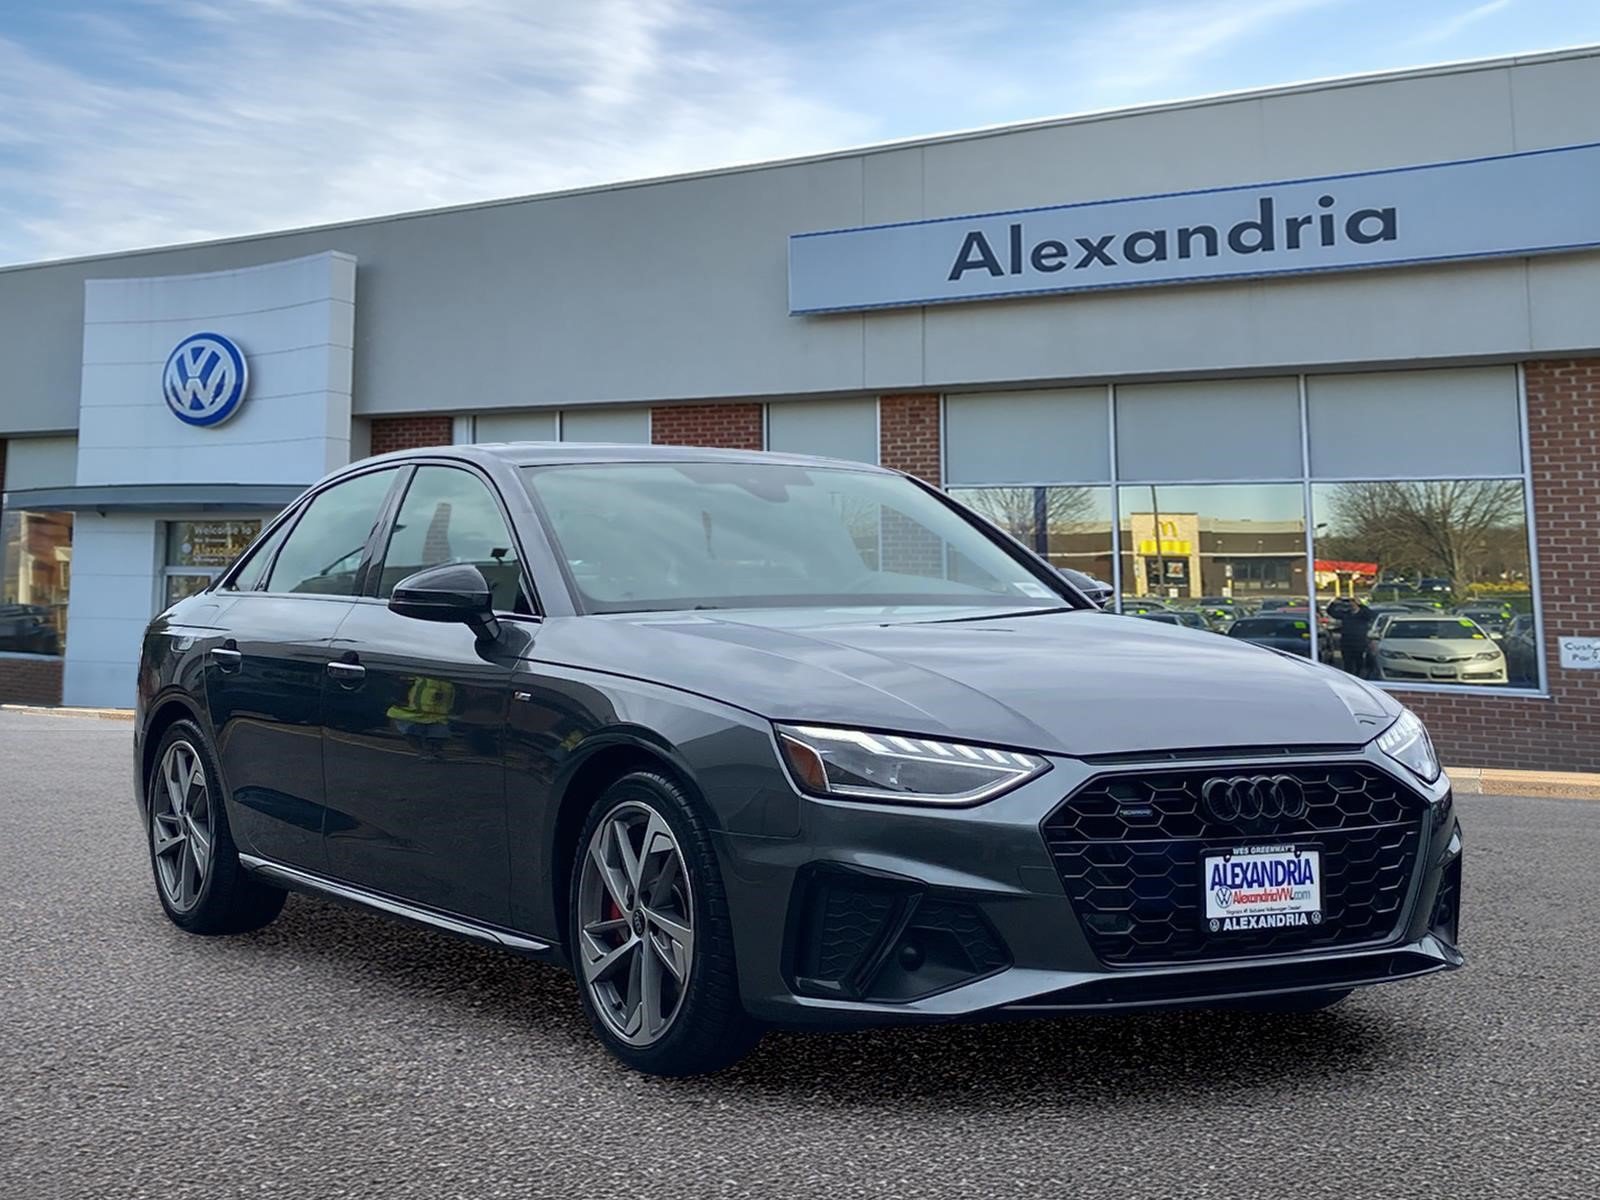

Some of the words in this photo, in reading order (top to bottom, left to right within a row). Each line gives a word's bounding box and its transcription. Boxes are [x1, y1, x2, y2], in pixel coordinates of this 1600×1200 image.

[948, 194, 1398, 281] Alexandria
[164, 336, 242, 424] VW
[1232, 846, 1249, 855] WES
[1210, 858, 1314, 891] ALEXANDRIA
[1223, 912, 1309, 931] ALEXANDRIA
